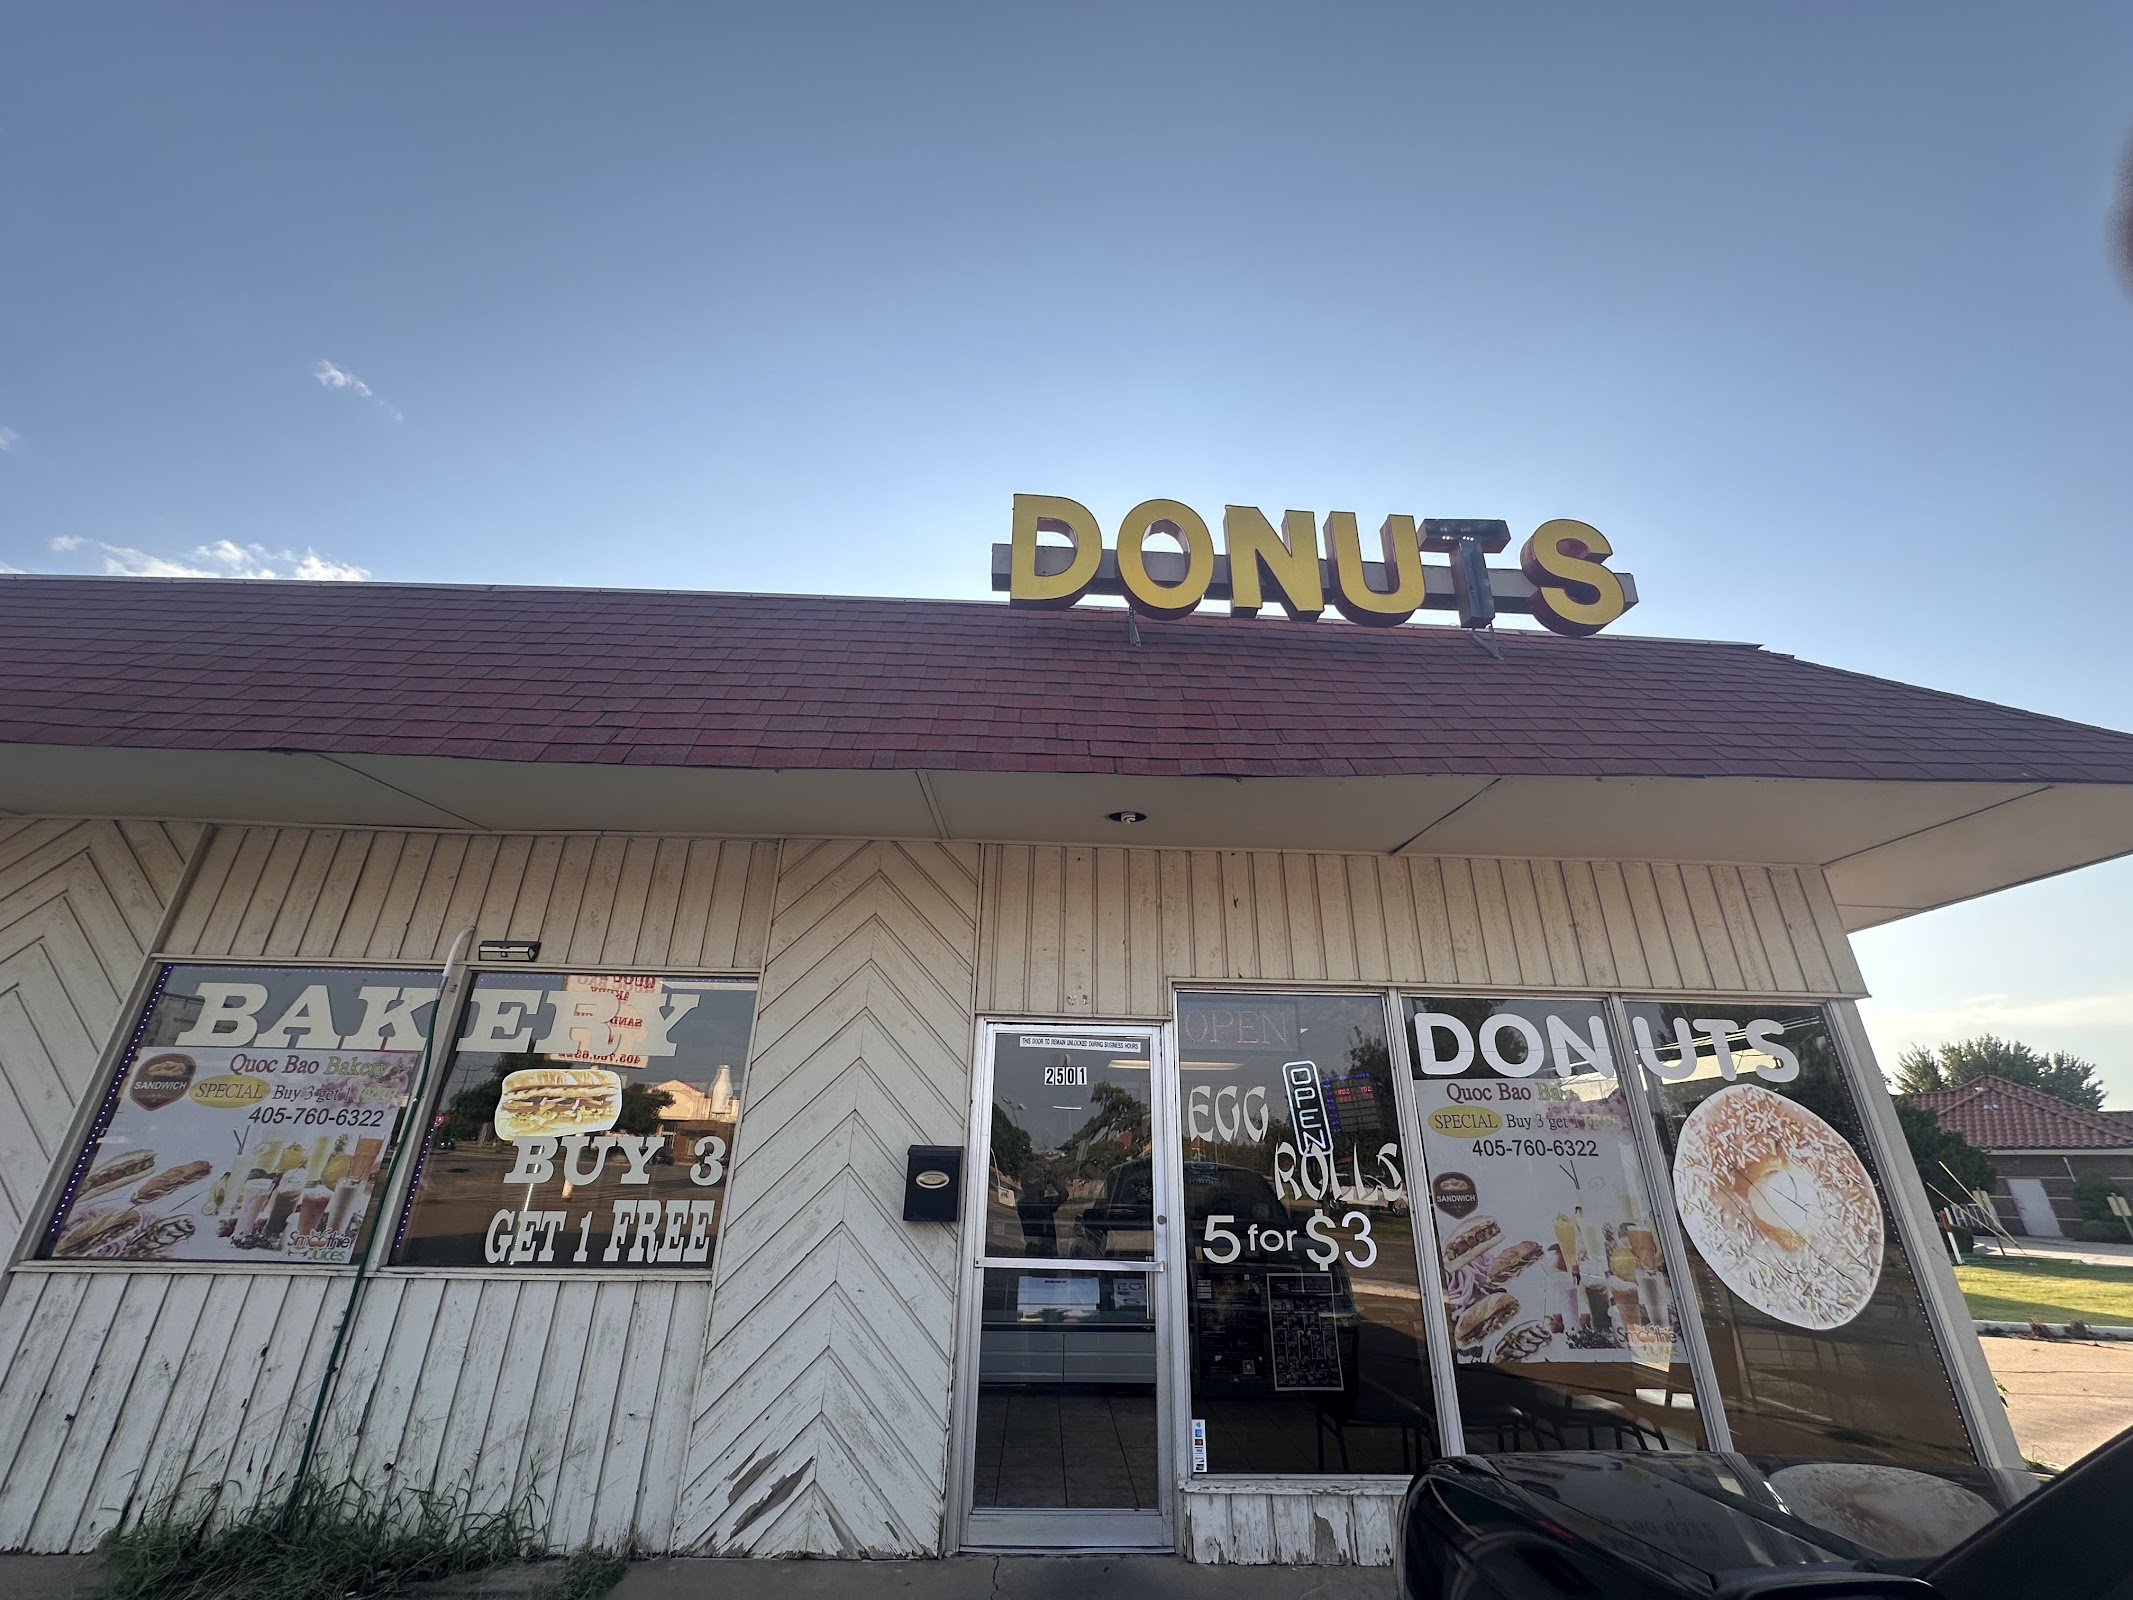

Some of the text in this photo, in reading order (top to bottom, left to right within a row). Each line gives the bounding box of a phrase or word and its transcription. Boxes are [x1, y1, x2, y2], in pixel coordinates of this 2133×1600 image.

[1010, 493, 1626, 634] DONUTS
[175, 982, 700, 1057] BAKERY
[1184, 1009, 1288, 1045] OPEN
[1022, 1037, 1031, 1045] THIS
[1067, 1039, 1088, 1047] UNLOCKED
[1088, 1040, 1103, 1048] DURING
[1104, 1041, 1124, 1049] BUSINESS
[1125, 1042, 1139, 1050] HOURS
[1414, 1012, 1800, 1083] DONUTS
[230, 1053, 390, 1081] Quoc Bao Bakery
[1045, 1067, 1086, 1085] 2501
[134, 1080, 188, 1091] SANDWICH
[195, 1083, 263, 1099] SPECIAL
[273, 1085, 300, 1102] Buy
[304, 1086, 315, 1099] 3
[316, 1087, 342, 1103] get
[1447, 1083, 1492, 1103] Quoc
[1496, 1083, 1531, 1101] Bao
[248, 1106, 384, 1128] 405-760-6322
[1188, 1085, 1269, 1142] EGG
[1290, 1067, 1326, 1154] OPEN
[1434, 1114, 1498, 1129] SPECIAL
[1505, 1114, 1531, 1131] Buy
[1535, 1114, 1544, 1128] 3
[1549, 1115, 1568, 1131] get
[1472, 1139, 1599, 1157] 405-760-6322
[503, 1136, 726, 1186] BUY 3
[1274, 1142, 1402, 1203] ROLLS
[1436, 1194, 1476, 1203] SANDWICH
[287, 1230, 351, 1249] Smoothie
[484, 1200, 715, 1264] GET 1 FREE
[1202, 1208, 1379, 1271] 5 for $3
[1617, 1326, 1677, 1344] Smoothie
